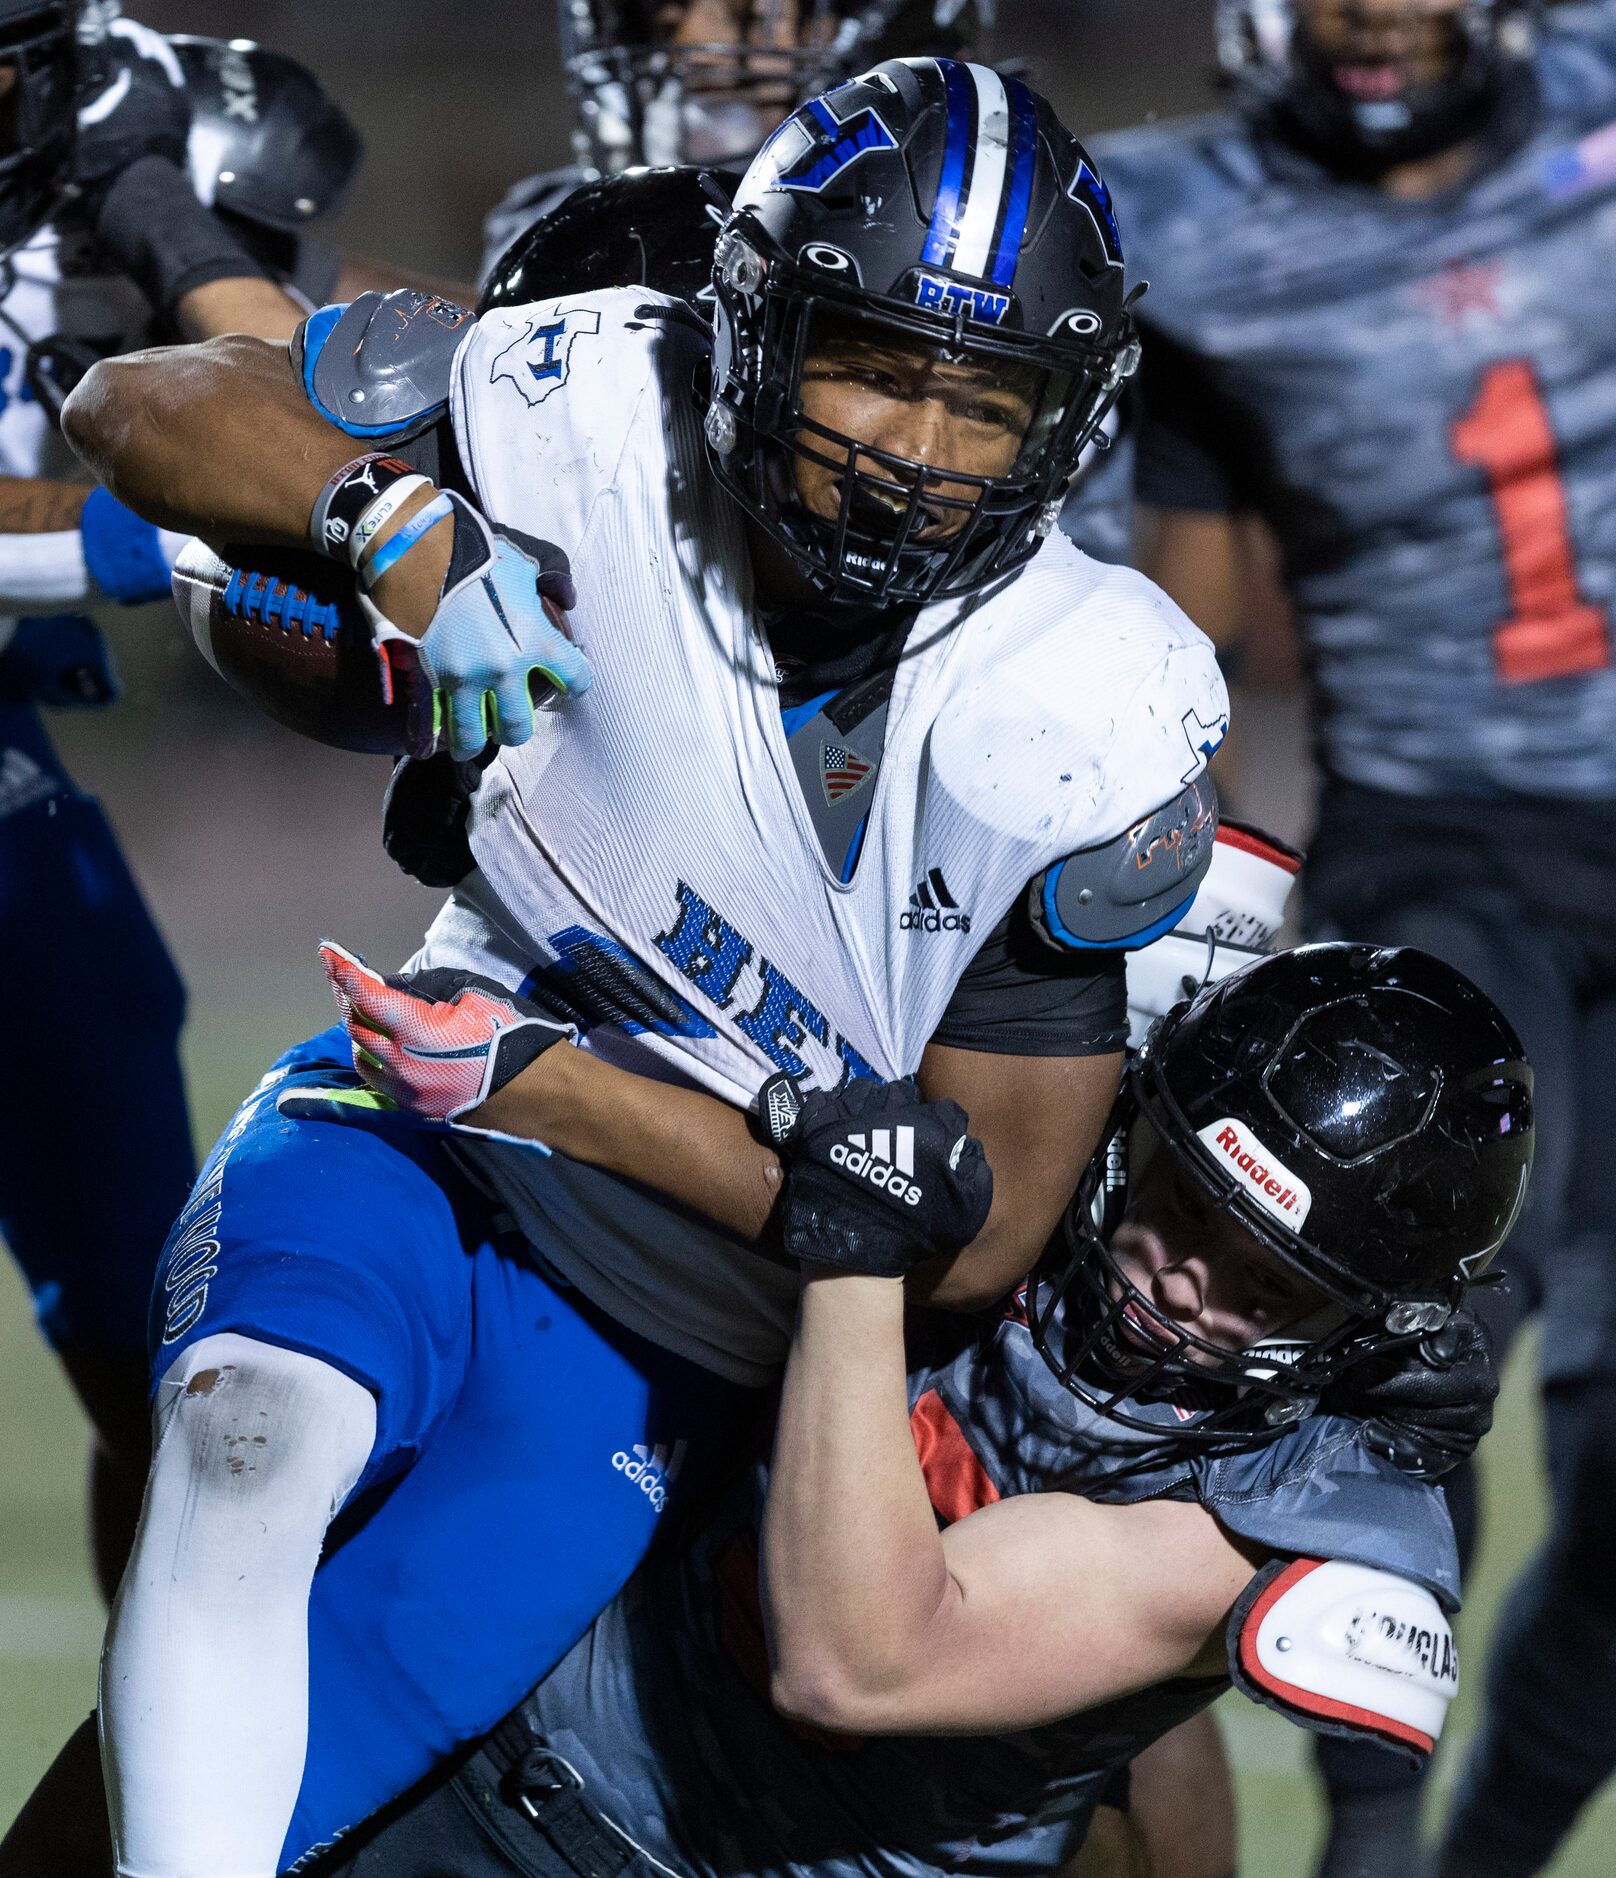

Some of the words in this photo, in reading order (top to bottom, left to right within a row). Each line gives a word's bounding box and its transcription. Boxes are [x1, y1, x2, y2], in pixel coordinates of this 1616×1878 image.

[914, 273, 1010, 325] BTW
[1450, 356, 1608, 684] 1
[899, 908, 970, 935] adidas
[829, 1143, 923, 1206] adidas
[1215, 1125, 1298, 1211] Riddell
[611, 1451, 669, 1513] adidas
